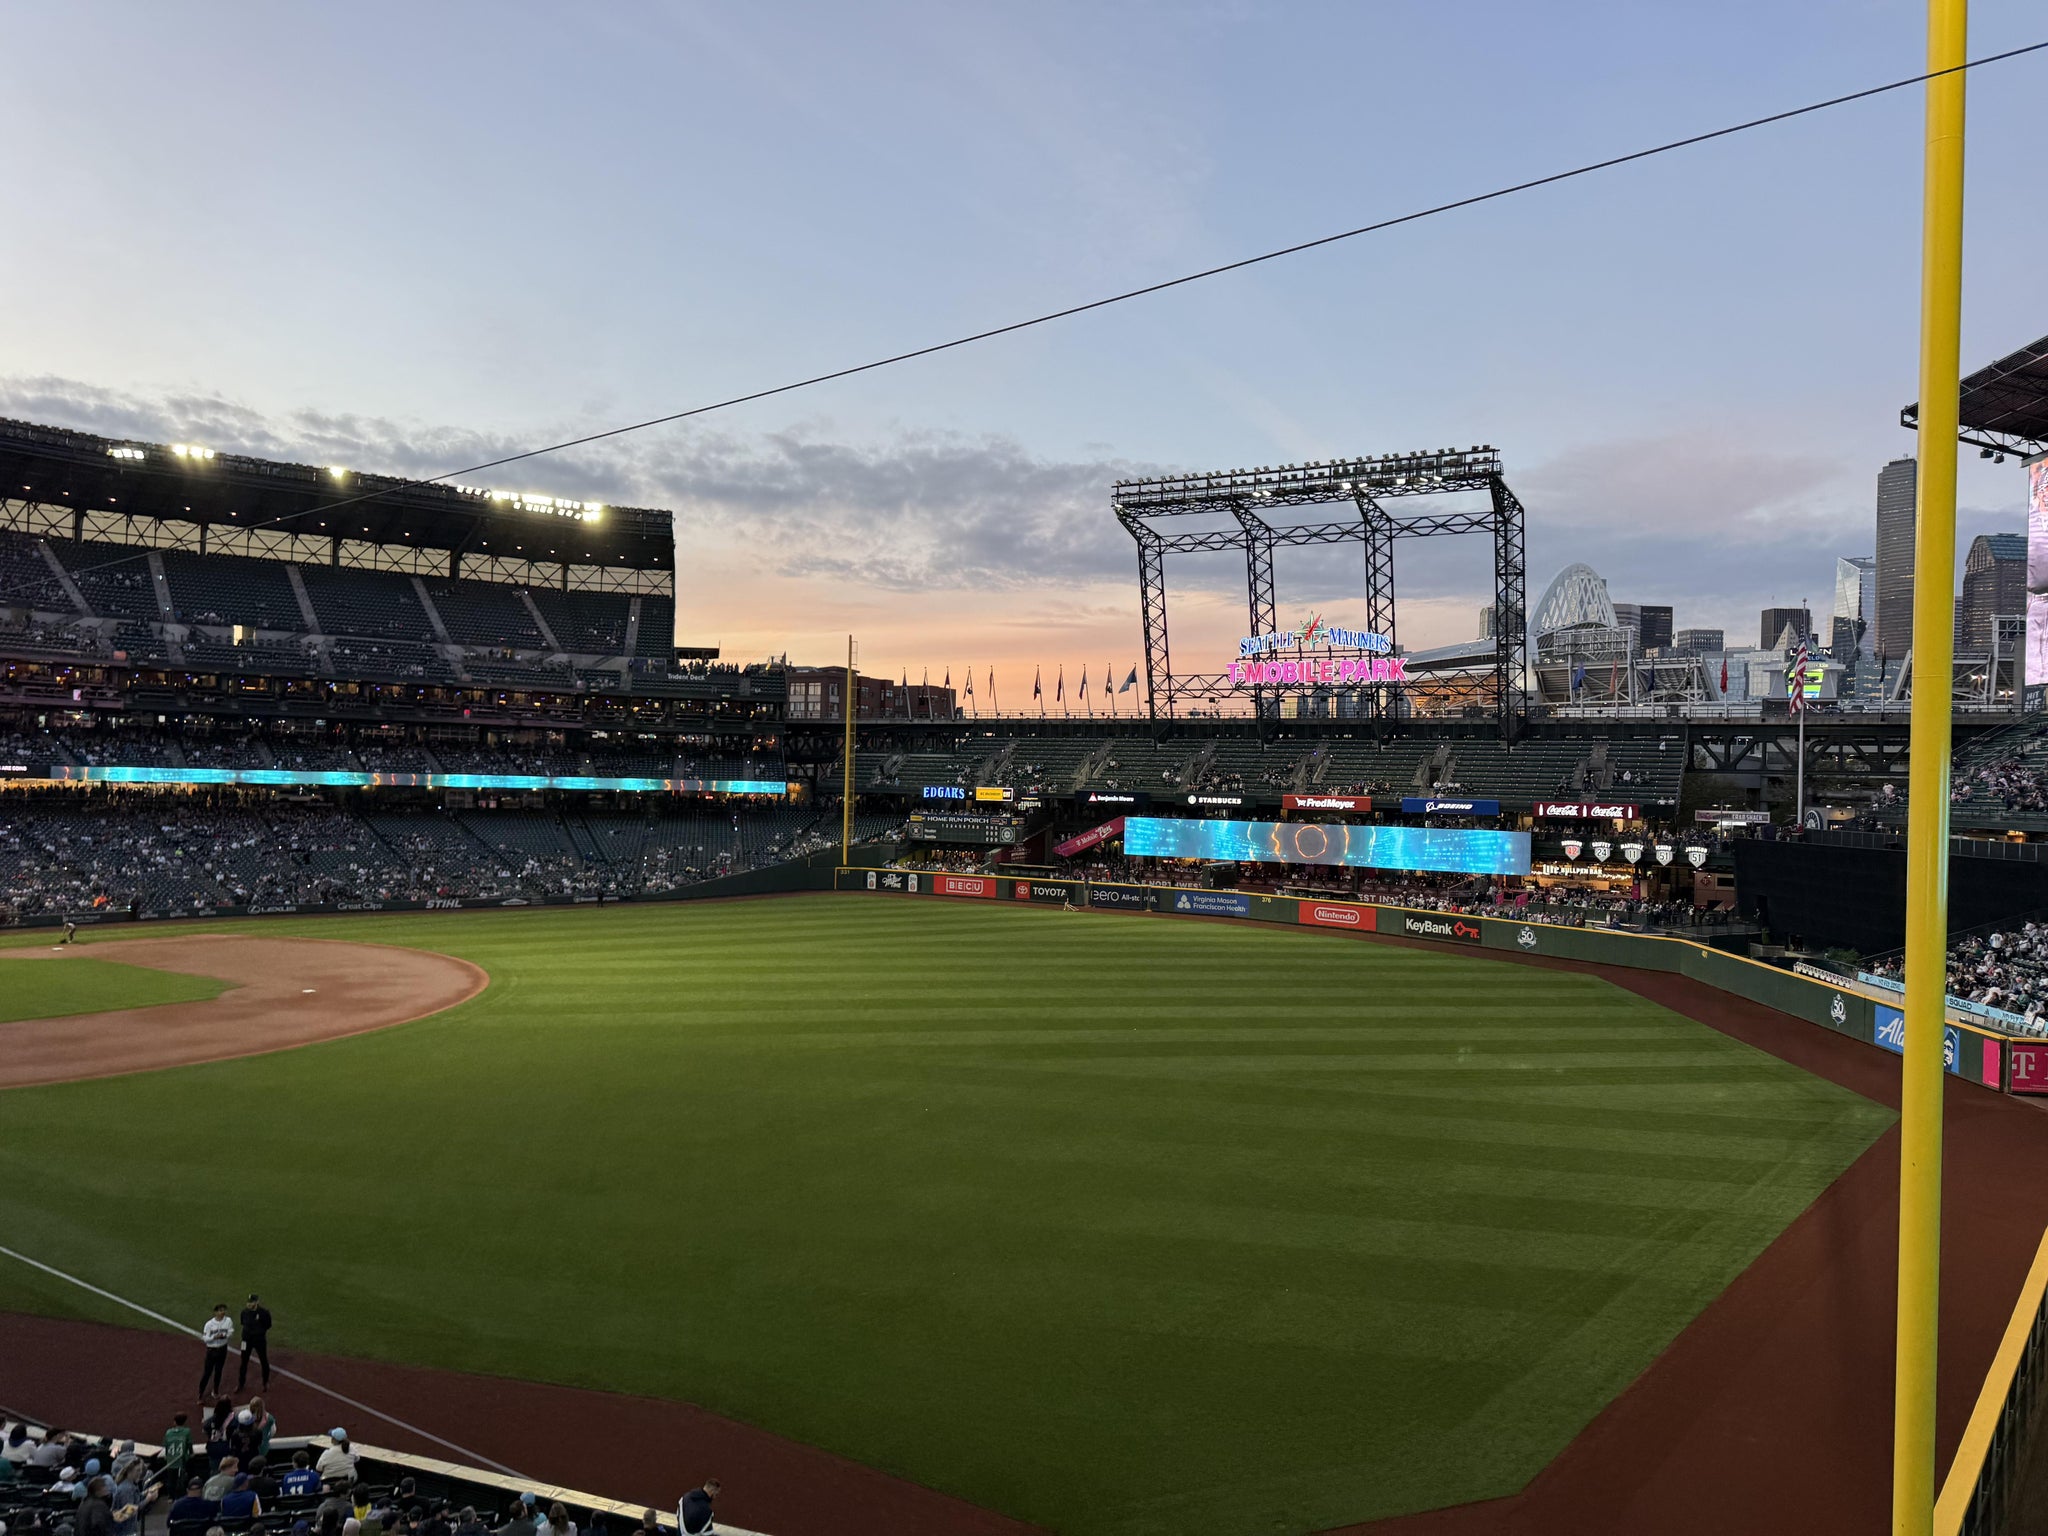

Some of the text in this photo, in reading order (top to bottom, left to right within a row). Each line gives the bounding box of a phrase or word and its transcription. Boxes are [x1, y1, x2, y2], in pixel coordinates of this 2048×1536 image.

[1239, 627, 1391, 656] SEATTLE MARINERS
[1226, 658, 1408, 684] T-MOBILE PARK
[1198, 797, 1242, 805] STARBUCKS
[1081, 833, 1098, 845] Mobile
[1095, 825, 1113, 838] Pen
[1567, 845, 1578, 856] 42
[1597, 848, 1607, 857] 24
[1659, 851, 1669, 860] 51
[1692, 853, 1701, 862] 51
[1589, 866, 1602, 875] BAR
[948, 881, 981, 891] BECU
[1032, 886, 1067, 897] TOYOTA
[426, 900, 463, 909] STIHL
[1193, 895, 1216, 904] Virginia
[337, 902, 383, 912] Great Clips
[1193, 903, 1226, 911] Franciscan
[1317, 909, 1357, 921] Nintendo
[1406, 918, 1452, 935] KeyBank
[1521, 930, 1534, 941] 50
[1834, 1000, 1844, 1016] 50
[1949, 998, 1972, 1010] SQUAD
[167, 1442, 184, 1457] 44
